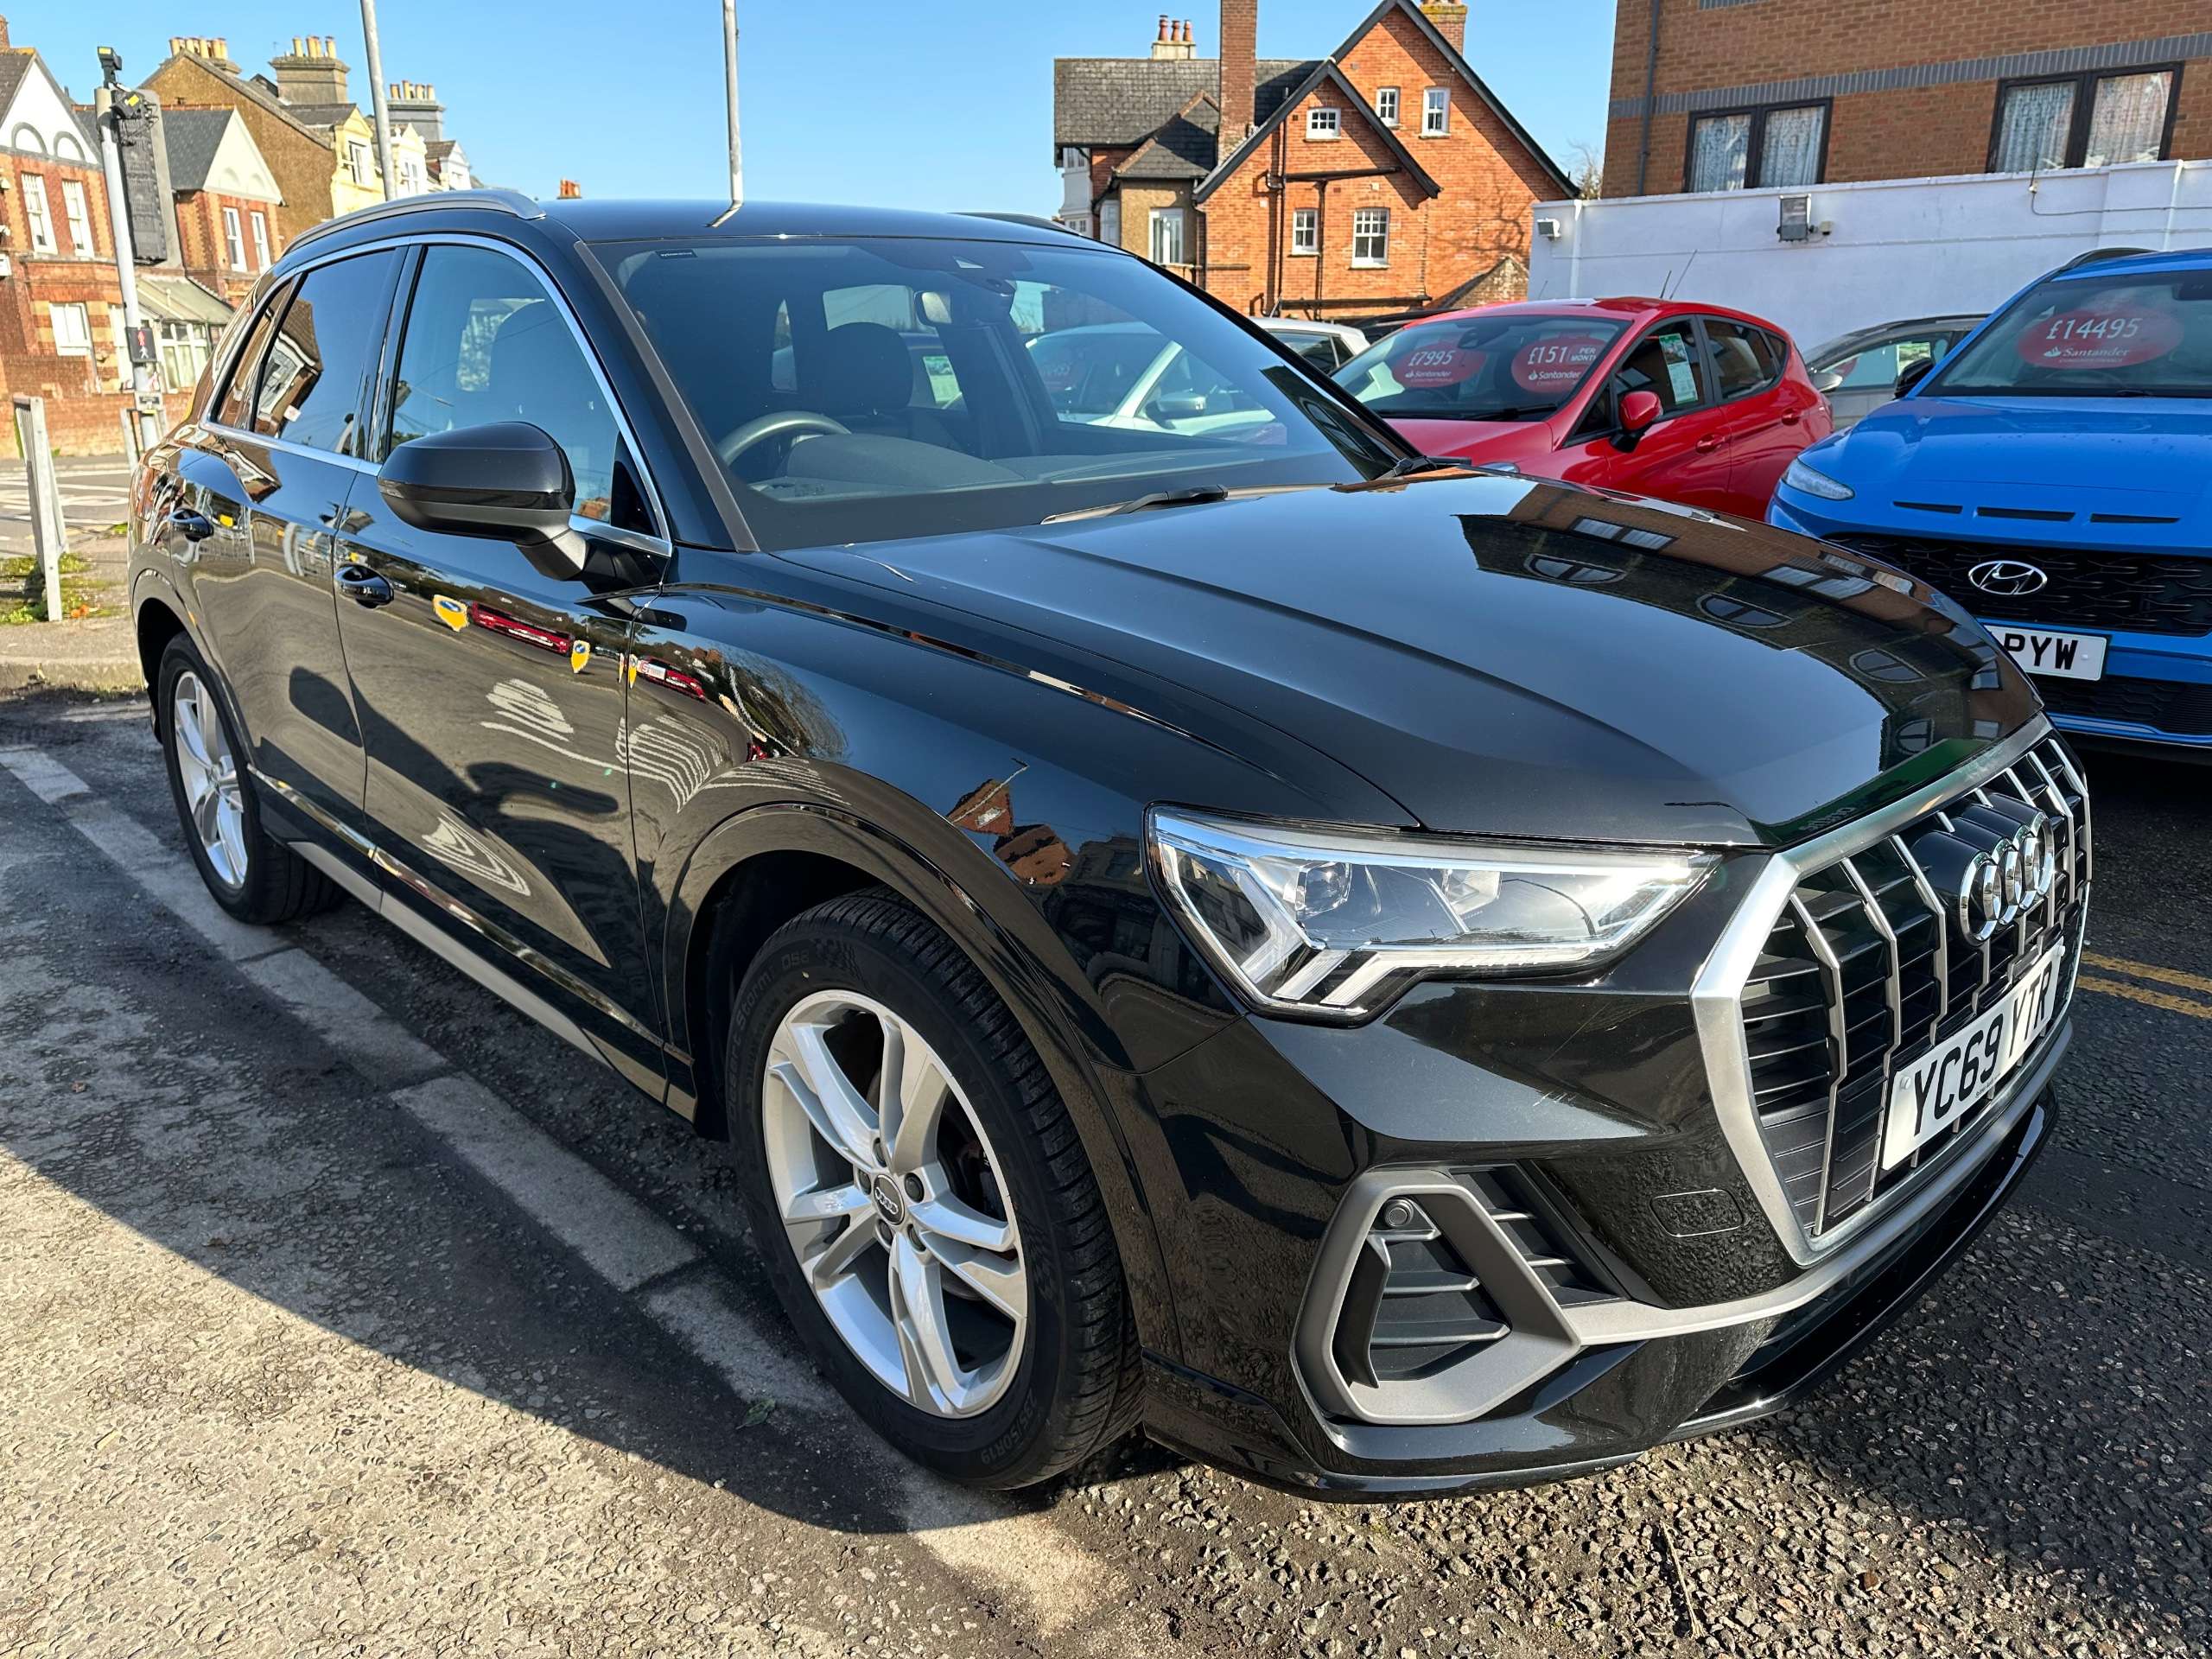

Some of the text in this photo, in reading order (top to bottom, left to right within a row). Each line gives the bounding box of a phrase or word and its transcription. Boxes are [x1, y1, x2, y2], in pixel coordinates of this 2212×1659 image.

[2046, 317, 2143, 340] £14495
[1408, 350, 1456, 367] £7995
[1528, 346, 1568, 365] £151
[2063, 346, 2130, 358] Santander
[1538, 370, 1582, 380] Santander
[2004, 632, 2079, 671] PYW
[1914, 961, 2053, 1138] YC69 YTR
